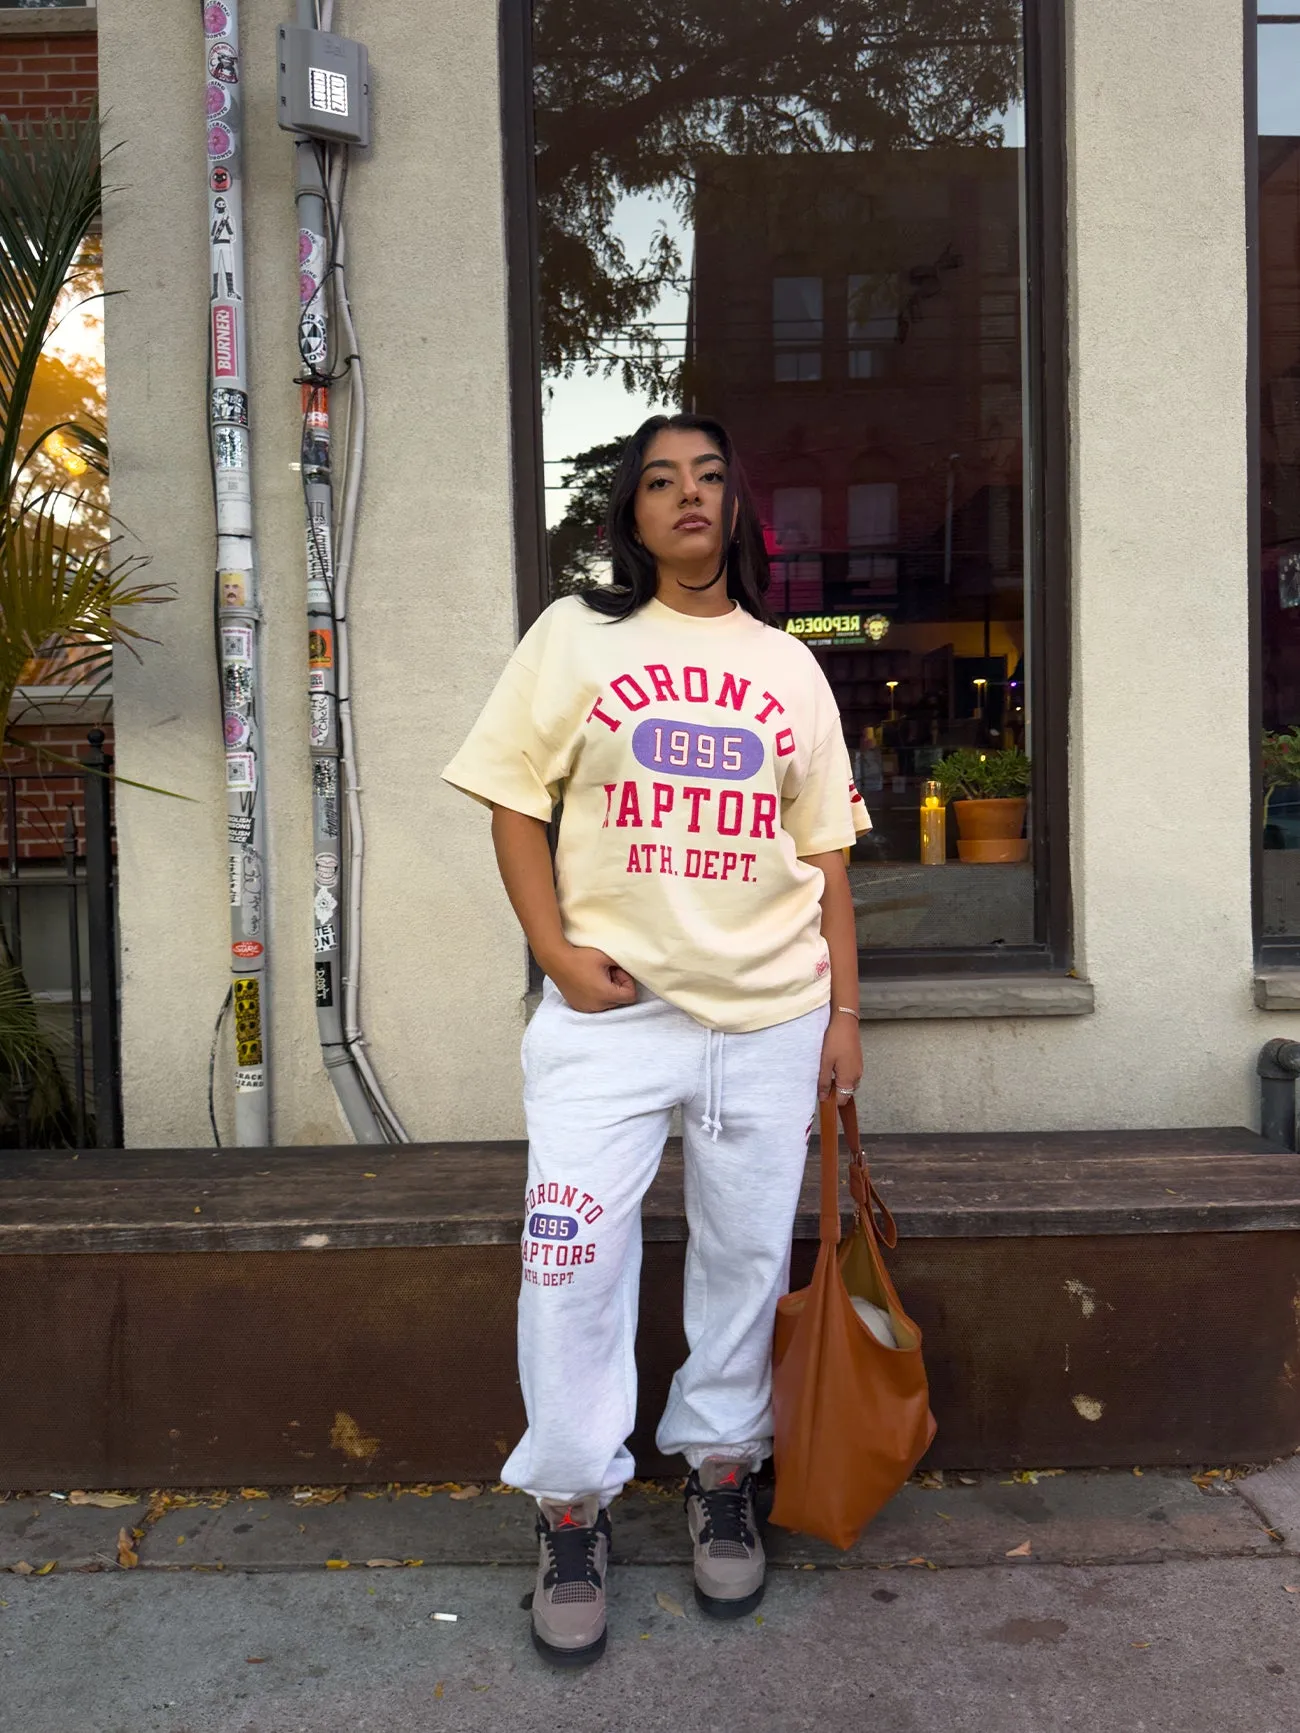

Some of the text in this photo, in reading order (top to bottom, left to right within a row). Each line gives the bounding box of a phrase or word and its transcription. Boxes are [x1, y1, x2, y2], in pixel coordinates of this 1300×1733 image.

[311, 70, 328, 109] KIRBY
[586, 664, 796, 757] TORONTO
[654, 727, 743, 771] 1995
[626, 844, 758, 883] ATH. DEPT.
[533, 1217, 570, 1237] 1995
[522, 1239, 596, 1266] APTORS
[543, 1271, 575, 1287] DEPT.
